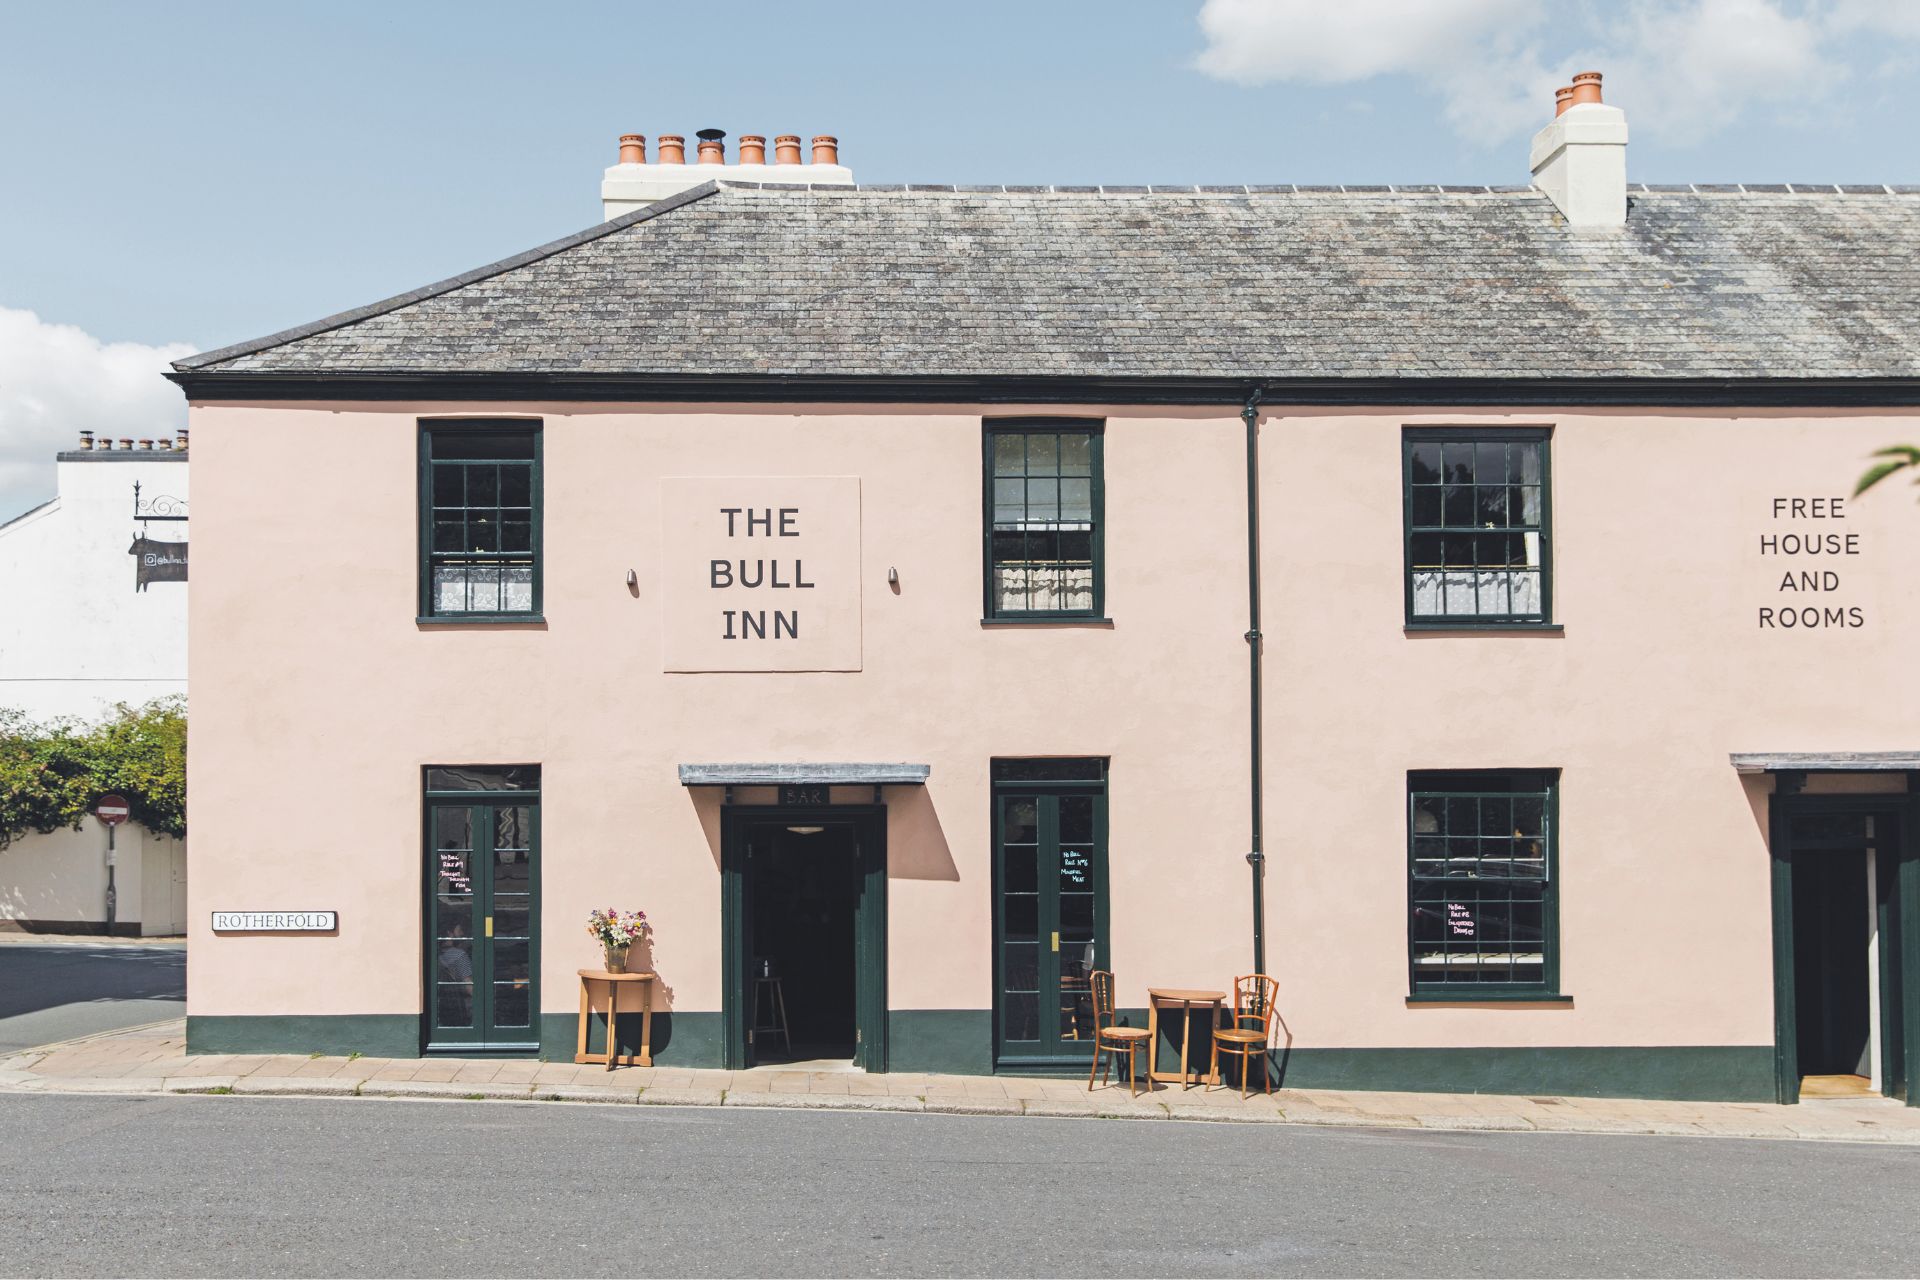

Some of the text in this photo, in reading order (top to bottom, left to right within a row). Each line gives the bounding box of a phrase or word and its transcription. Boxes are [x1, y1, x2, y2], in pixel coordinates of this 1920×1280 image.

[1774, 498, 1845, 519] FREE
[720, 508, 800, 537] THE
[1760, 534, 1860, 555] HOUSE
[710, 559, 815, 589] BULL
[1779, 571, 1839, 592] AND
[722, 610, 798, 640] INN
[1759, 607, 1864, 629] ROOMS
[786, 790, 822, 804] BAR
[218, 914, 328, 928] ROTHERFOLD
